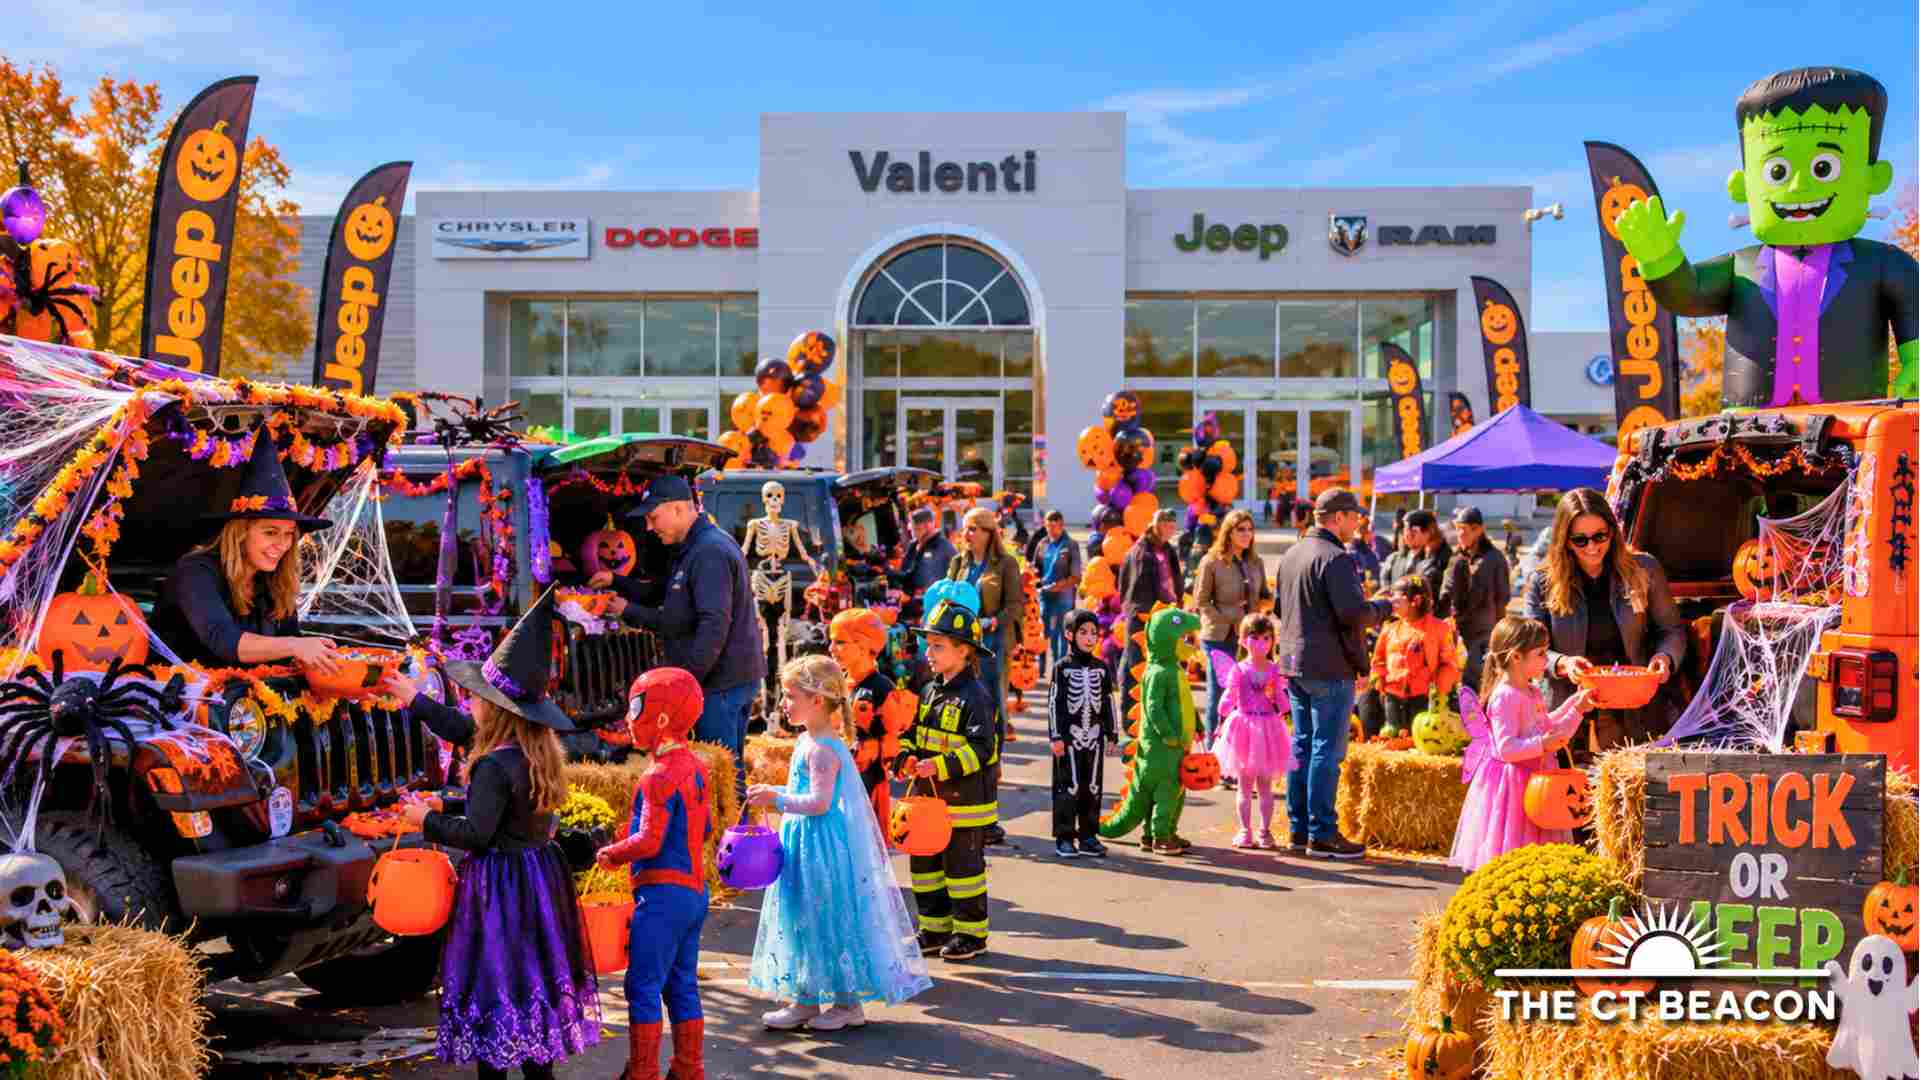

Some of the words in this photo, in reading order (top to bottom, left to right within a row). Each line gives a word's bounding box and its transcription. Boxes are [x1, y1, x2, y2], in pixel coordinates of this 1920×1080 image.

[848, 149, 1037, 193] Valenti
[438, 221, 577, 233] CHRYSLER
[605, 227, 759, 249] DODGE
[1174, 213, 1289, 260] Jeep
[1377, 225, 1497, 246] RAM
[156, 210, 223, 373] Jeep
[323, 265, 380, 398] Jeep
[1494, 347, 1520, 413] eep
[1667, 771, 1857, 849] TRICK
[1729, 851, 1791, 900] OR
